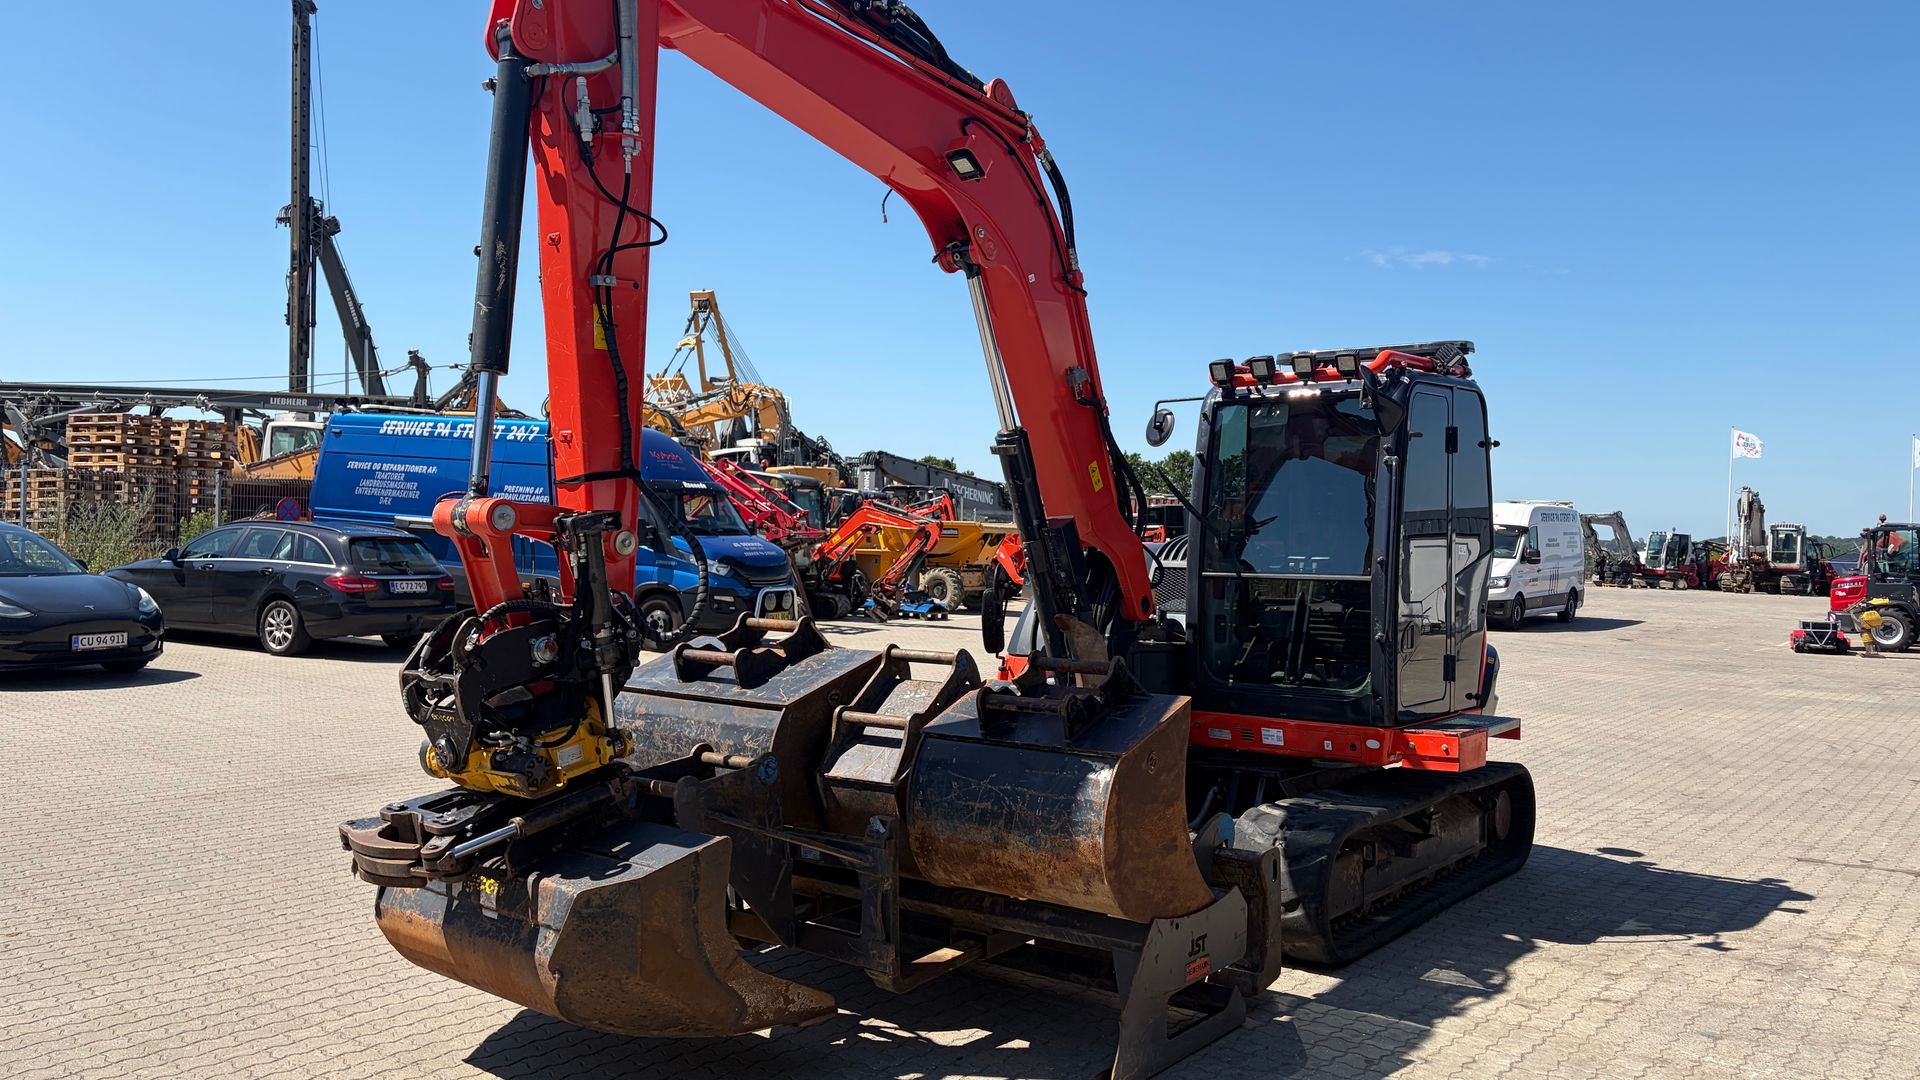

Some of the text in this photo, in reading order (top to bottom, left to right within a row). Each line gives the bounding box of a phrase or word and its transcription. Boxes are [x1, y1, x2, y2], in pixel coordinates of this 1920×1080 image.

[343, 289, 361, 329] LIEBHERR
[270, 396, 308, 406] LIEBHERR
[379, 420, 434, 437] SERVICE
[434, 420, 453, 438] PÅ
[506, 425, 541, 442] 24/7
[346, 461, 372, 470] SERVICE
[372, 462, 381, 470] OG
[381, 463, 427, 473] REPARATIONER
[374, 471, 405, 481] TRAKTORER
[359, 479, 418, 490] LANDBRUGSMASKINER
[503, 484, 544, 495] PRESNING AF
[952, 483, 994, 505] TSCHERNING
[396, 582, 405, 591] EG
[80, 635, 125, 646] CU 94 911
[1187, 933, 1208, 957] JST
